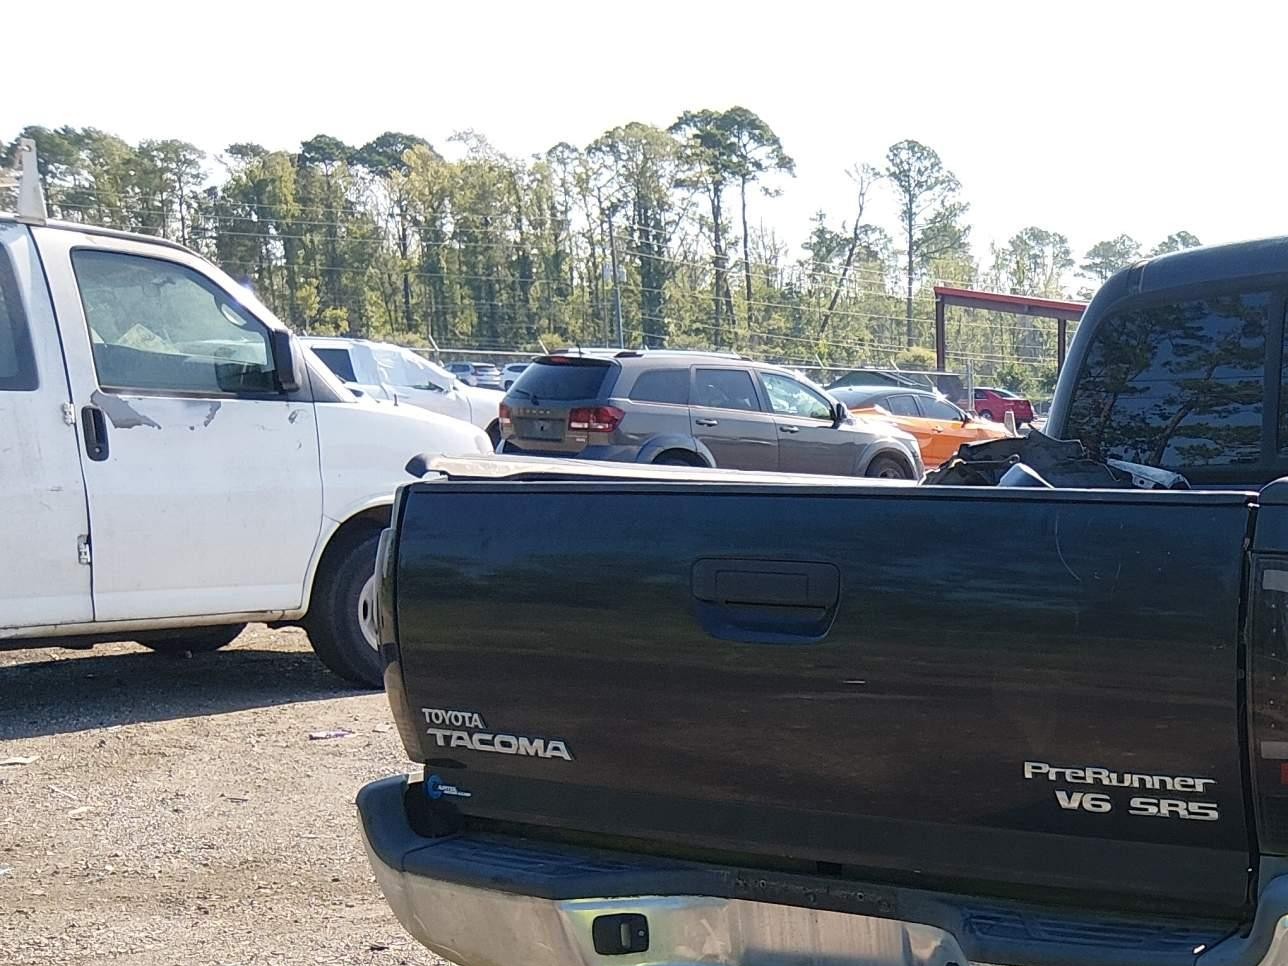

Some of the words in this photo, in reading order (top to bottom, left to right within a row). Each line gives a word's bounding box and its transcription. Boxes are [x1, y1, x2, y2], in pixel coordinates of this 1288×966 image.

[421, 707, 485, 729] TOYOTA
[426, 729, 574, 761] TACOMA
[1023, 761, 1217, 793] PreRunner
[1055, 790, 1112, 813] V6
[1128, 797, 1219, 821] SR5
